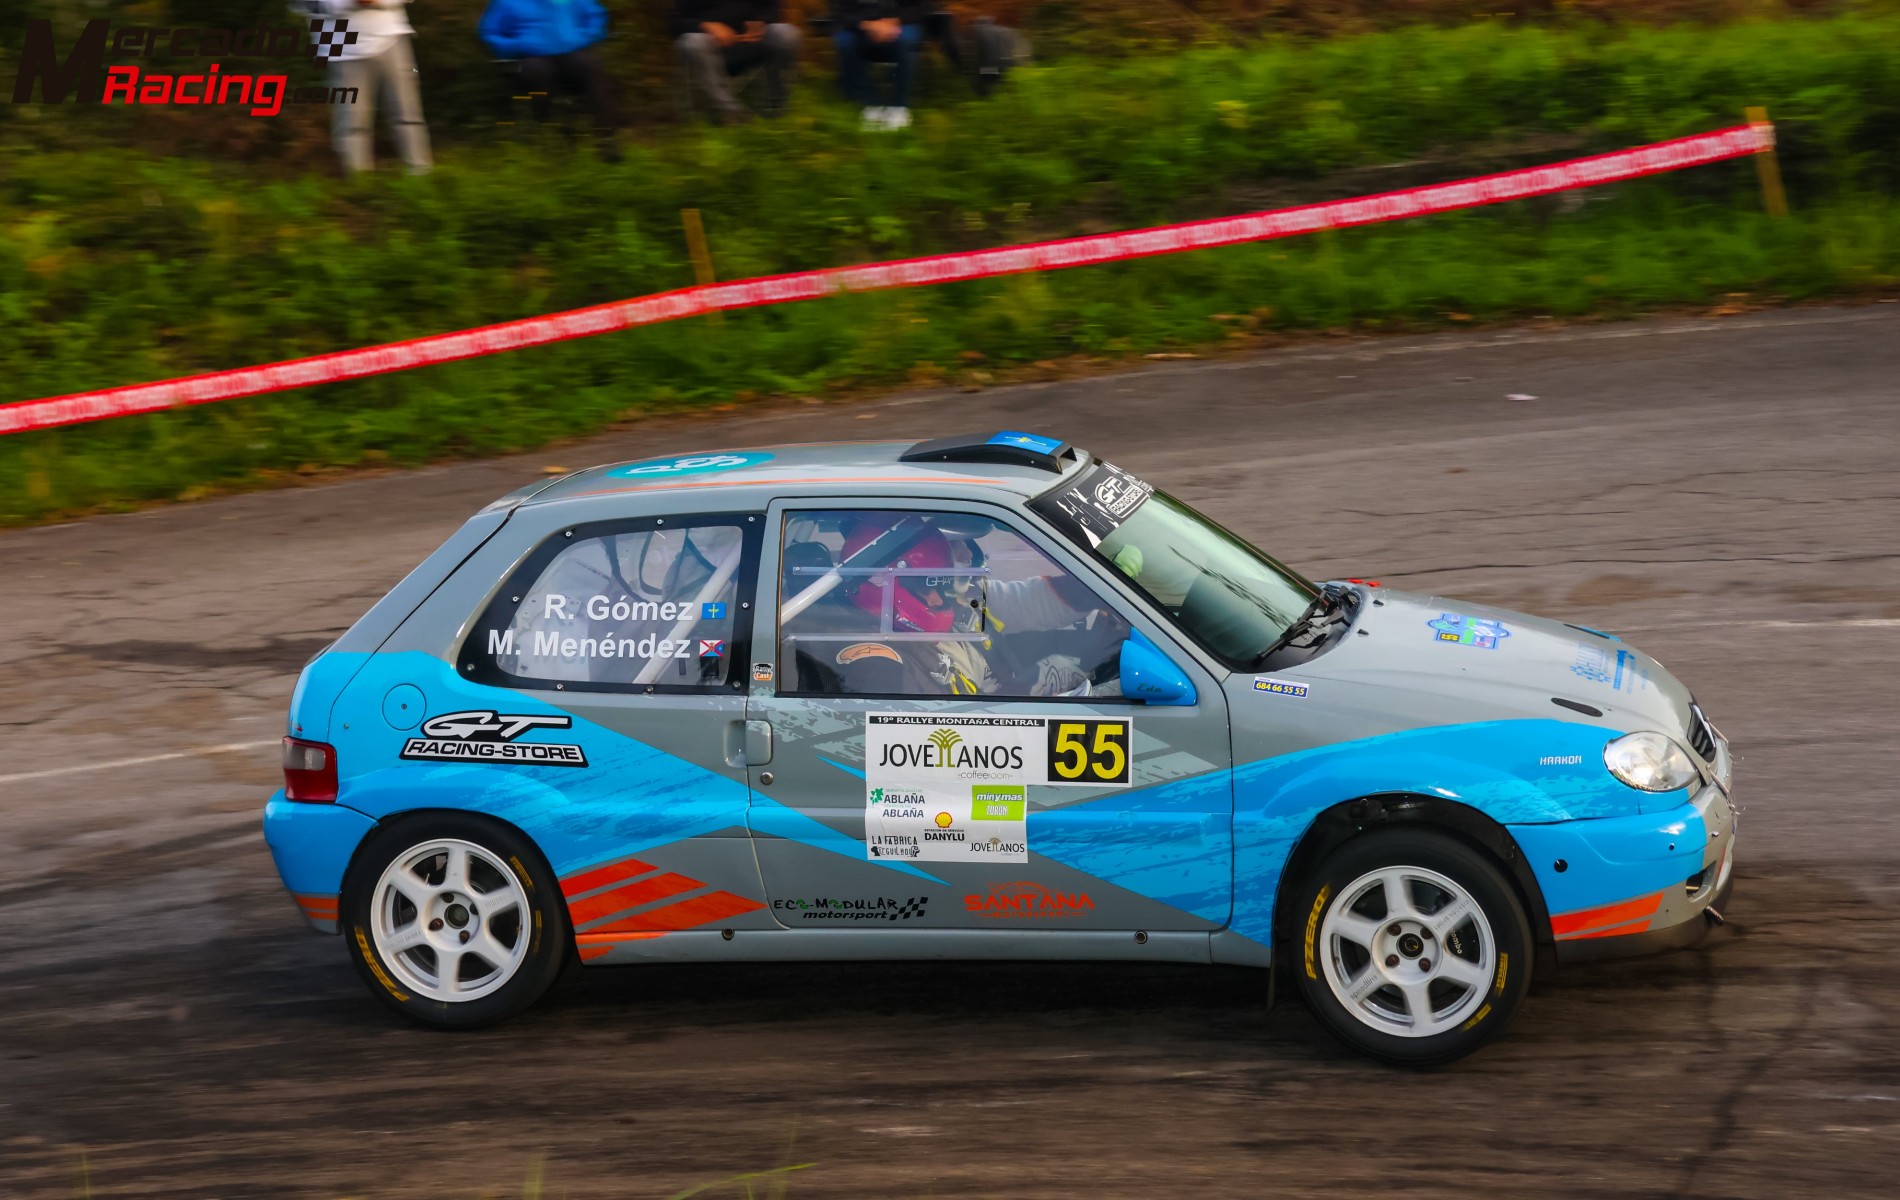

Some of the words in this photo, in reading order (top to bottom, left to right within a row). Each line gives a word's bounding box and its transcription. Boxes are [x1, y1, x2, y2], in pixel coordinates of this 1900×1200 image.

[544, 594, 574, 619] R.
[586, 595, 693, 620] Gómez
[487, 629, 521, 655] M.
[534, 631, 691, 658] Menéndez
[1256, 682, 1271, 690] 684
[1272, 684, 1282, 692] 66
[1283, 685, 1293, 694] 55
[1294, 687, 1305, 695] 55
[423, 711, 569, 739] GT
[407, 741, 581, 760] RACING-STORE
[1054, 723, 1126, 780] 55
[884, 793, 925, 804] ABLAÑA
[882, 808, 924, 818] ABLAÑA
[872, 835, 881, 845] LA
[924, 832, 965, 841] DANYLU
[963, 893, 1095, 911] SANTANA
[803, 910, 888, 920] motorsport
